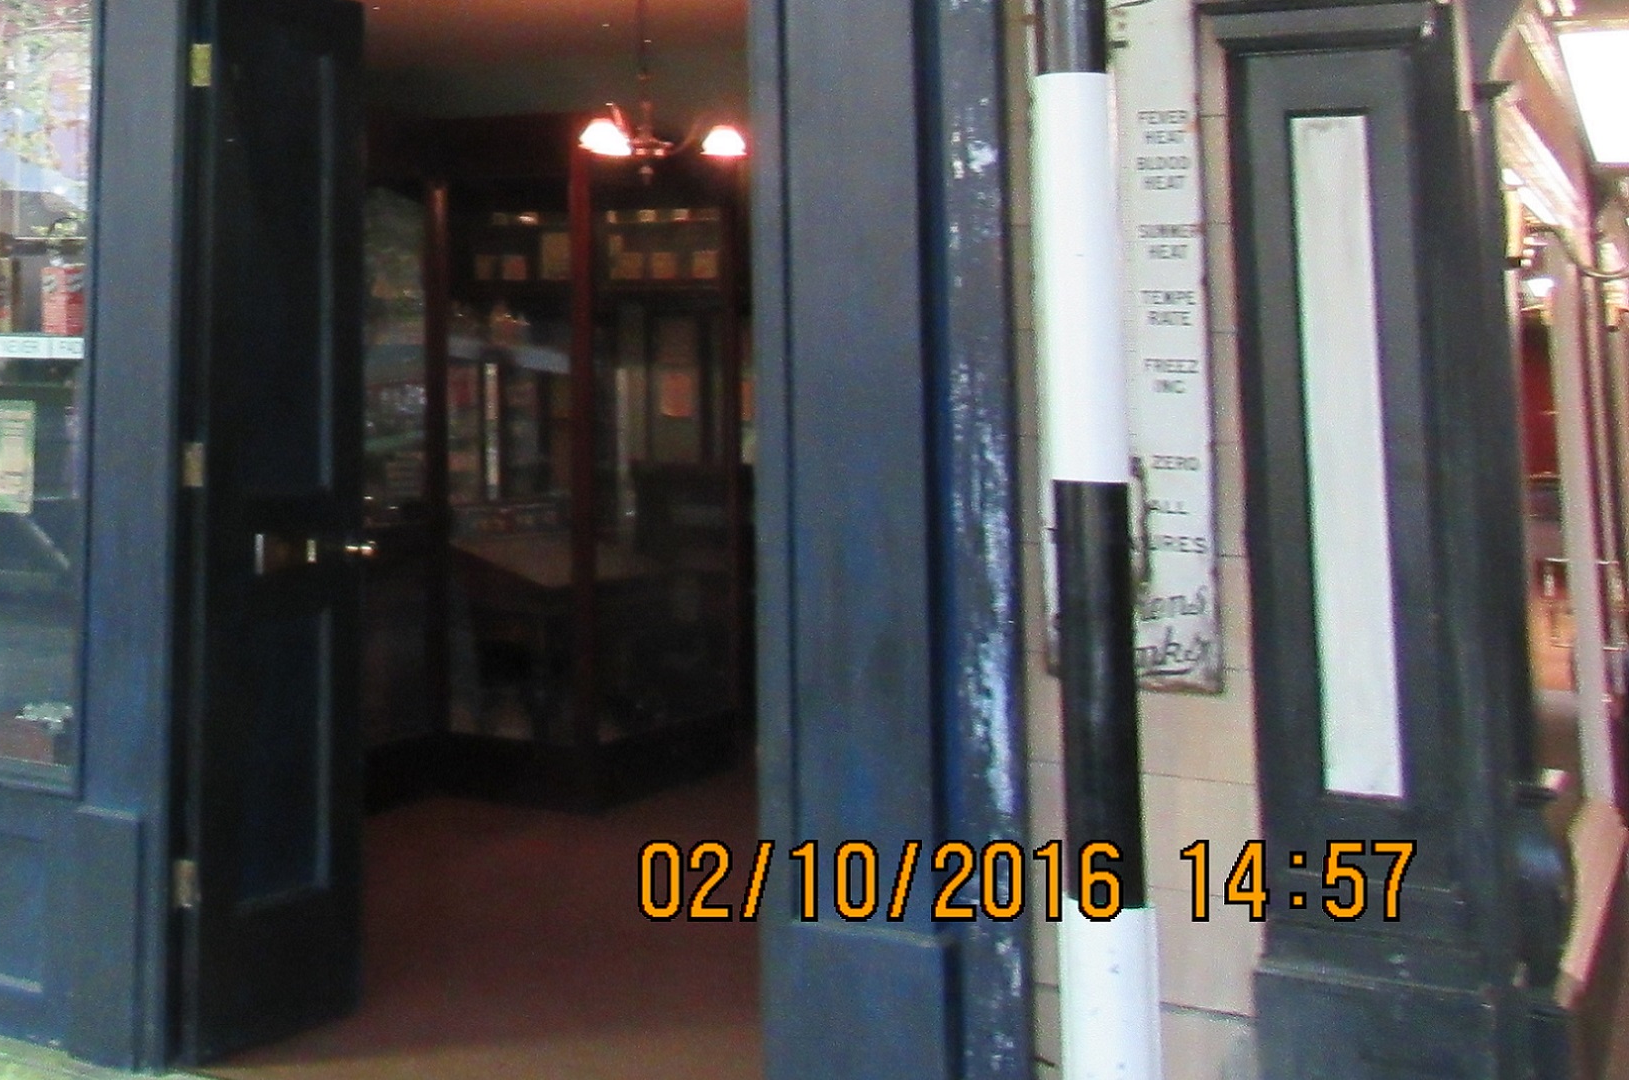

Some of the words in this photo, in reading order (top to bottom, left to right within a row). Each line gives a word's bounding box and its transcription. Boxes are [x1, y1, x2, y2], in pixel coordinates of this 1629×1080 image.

[1137, 109, 1189, 125] FEVER
[1144, 129, 1186, 145] HEAT
[1136, 155, 1191, 171] BLOOD
[1143, 175, 1186, 191] HEAT
[1148, 243, 1188, 260] HEAT
[1140, 288, 1197, 306] TEMPE
[1148, 309, 1194, 327] RATE
[1143, 357, 1200, 375] FREEZ
[1150, 454, 1202, 472] ZERO
